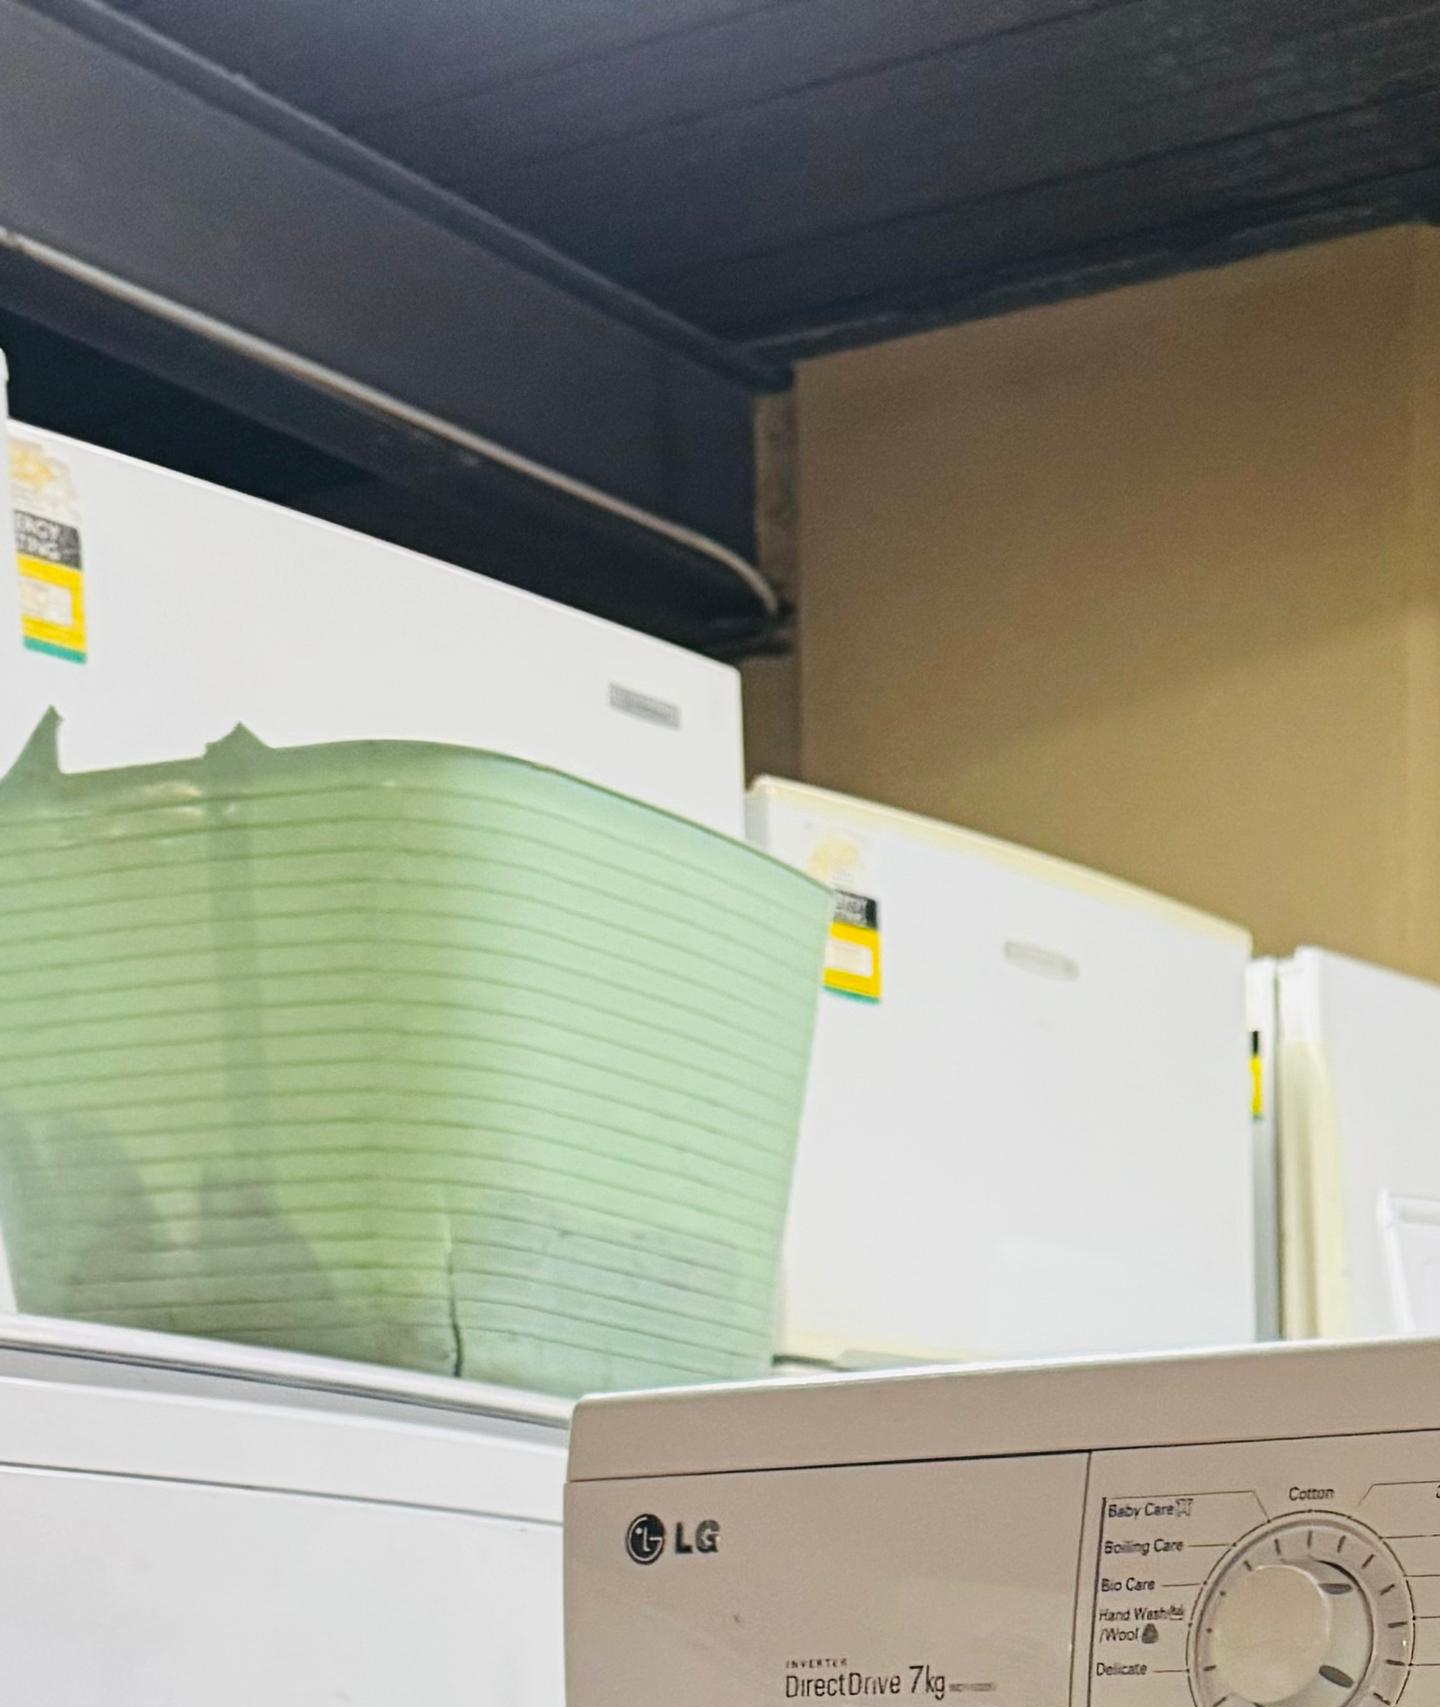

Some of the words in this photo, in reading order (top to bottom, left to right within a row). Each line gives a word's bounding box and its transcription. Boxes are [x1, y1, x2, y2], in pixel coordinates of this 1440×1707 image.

[1289, 1486, 1335, 1501] Cotton
[1108, 1504, 1140, 1519] Baby
[1145, 1503, 1174, 1516] Care
[675, 1520, 719, 1553] LG
[1154, 1539, 1183, 1552] Care
[1101, 1578, 1122, 1592] Bio
[1126, 1577, 1155, 1591] Care
[1099, 1608, 1130, 1621] Hand
[1134, 1607, 1168, 1621] Wash
[786, 1657, 848, 1669] INVERTER
[1096, 1662, 1147, 1676] Delicate
